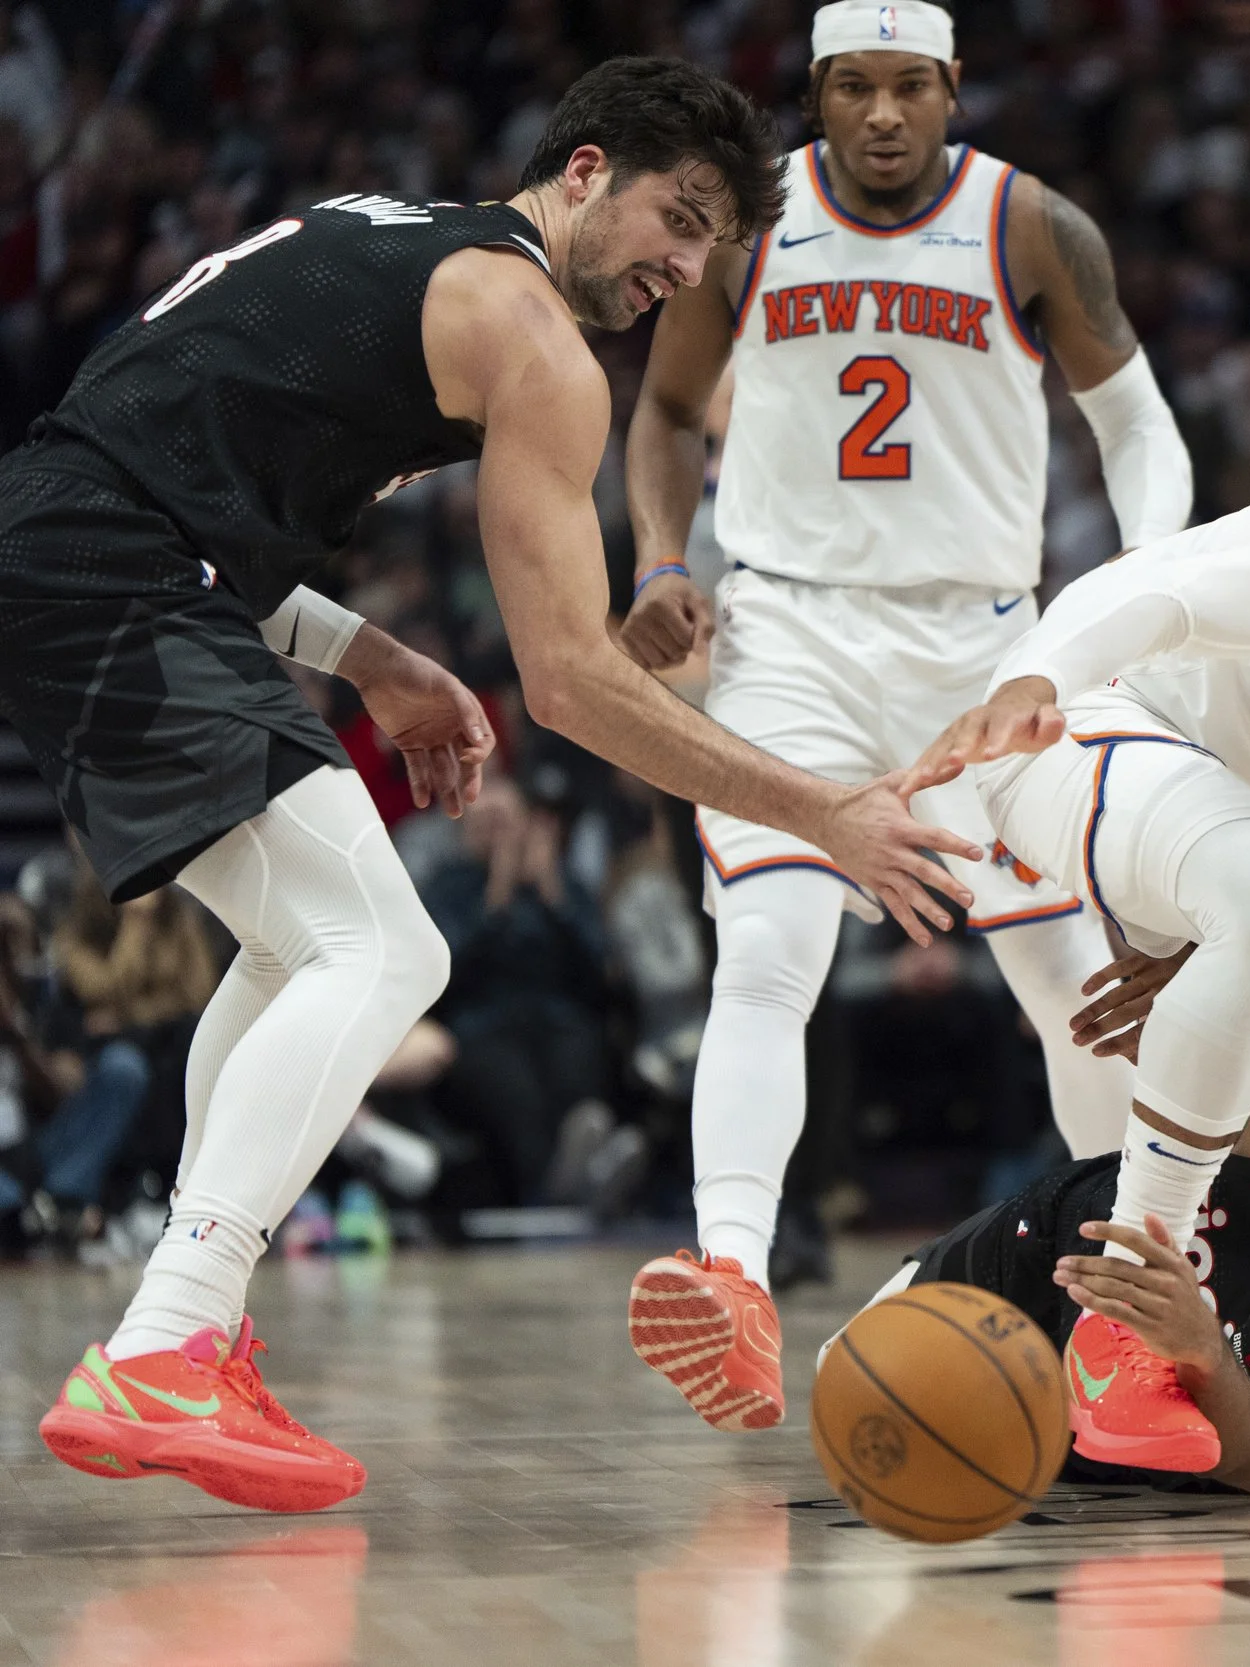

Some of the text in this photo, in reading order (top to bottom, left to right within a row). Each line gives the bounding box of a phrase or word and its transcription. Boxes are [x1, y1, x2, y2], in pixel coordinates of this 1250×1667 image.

[142, 217, 304, 323] 8
[763, 280, 992, 353] NEW YORK
[838, 355, 911, 480] 2
